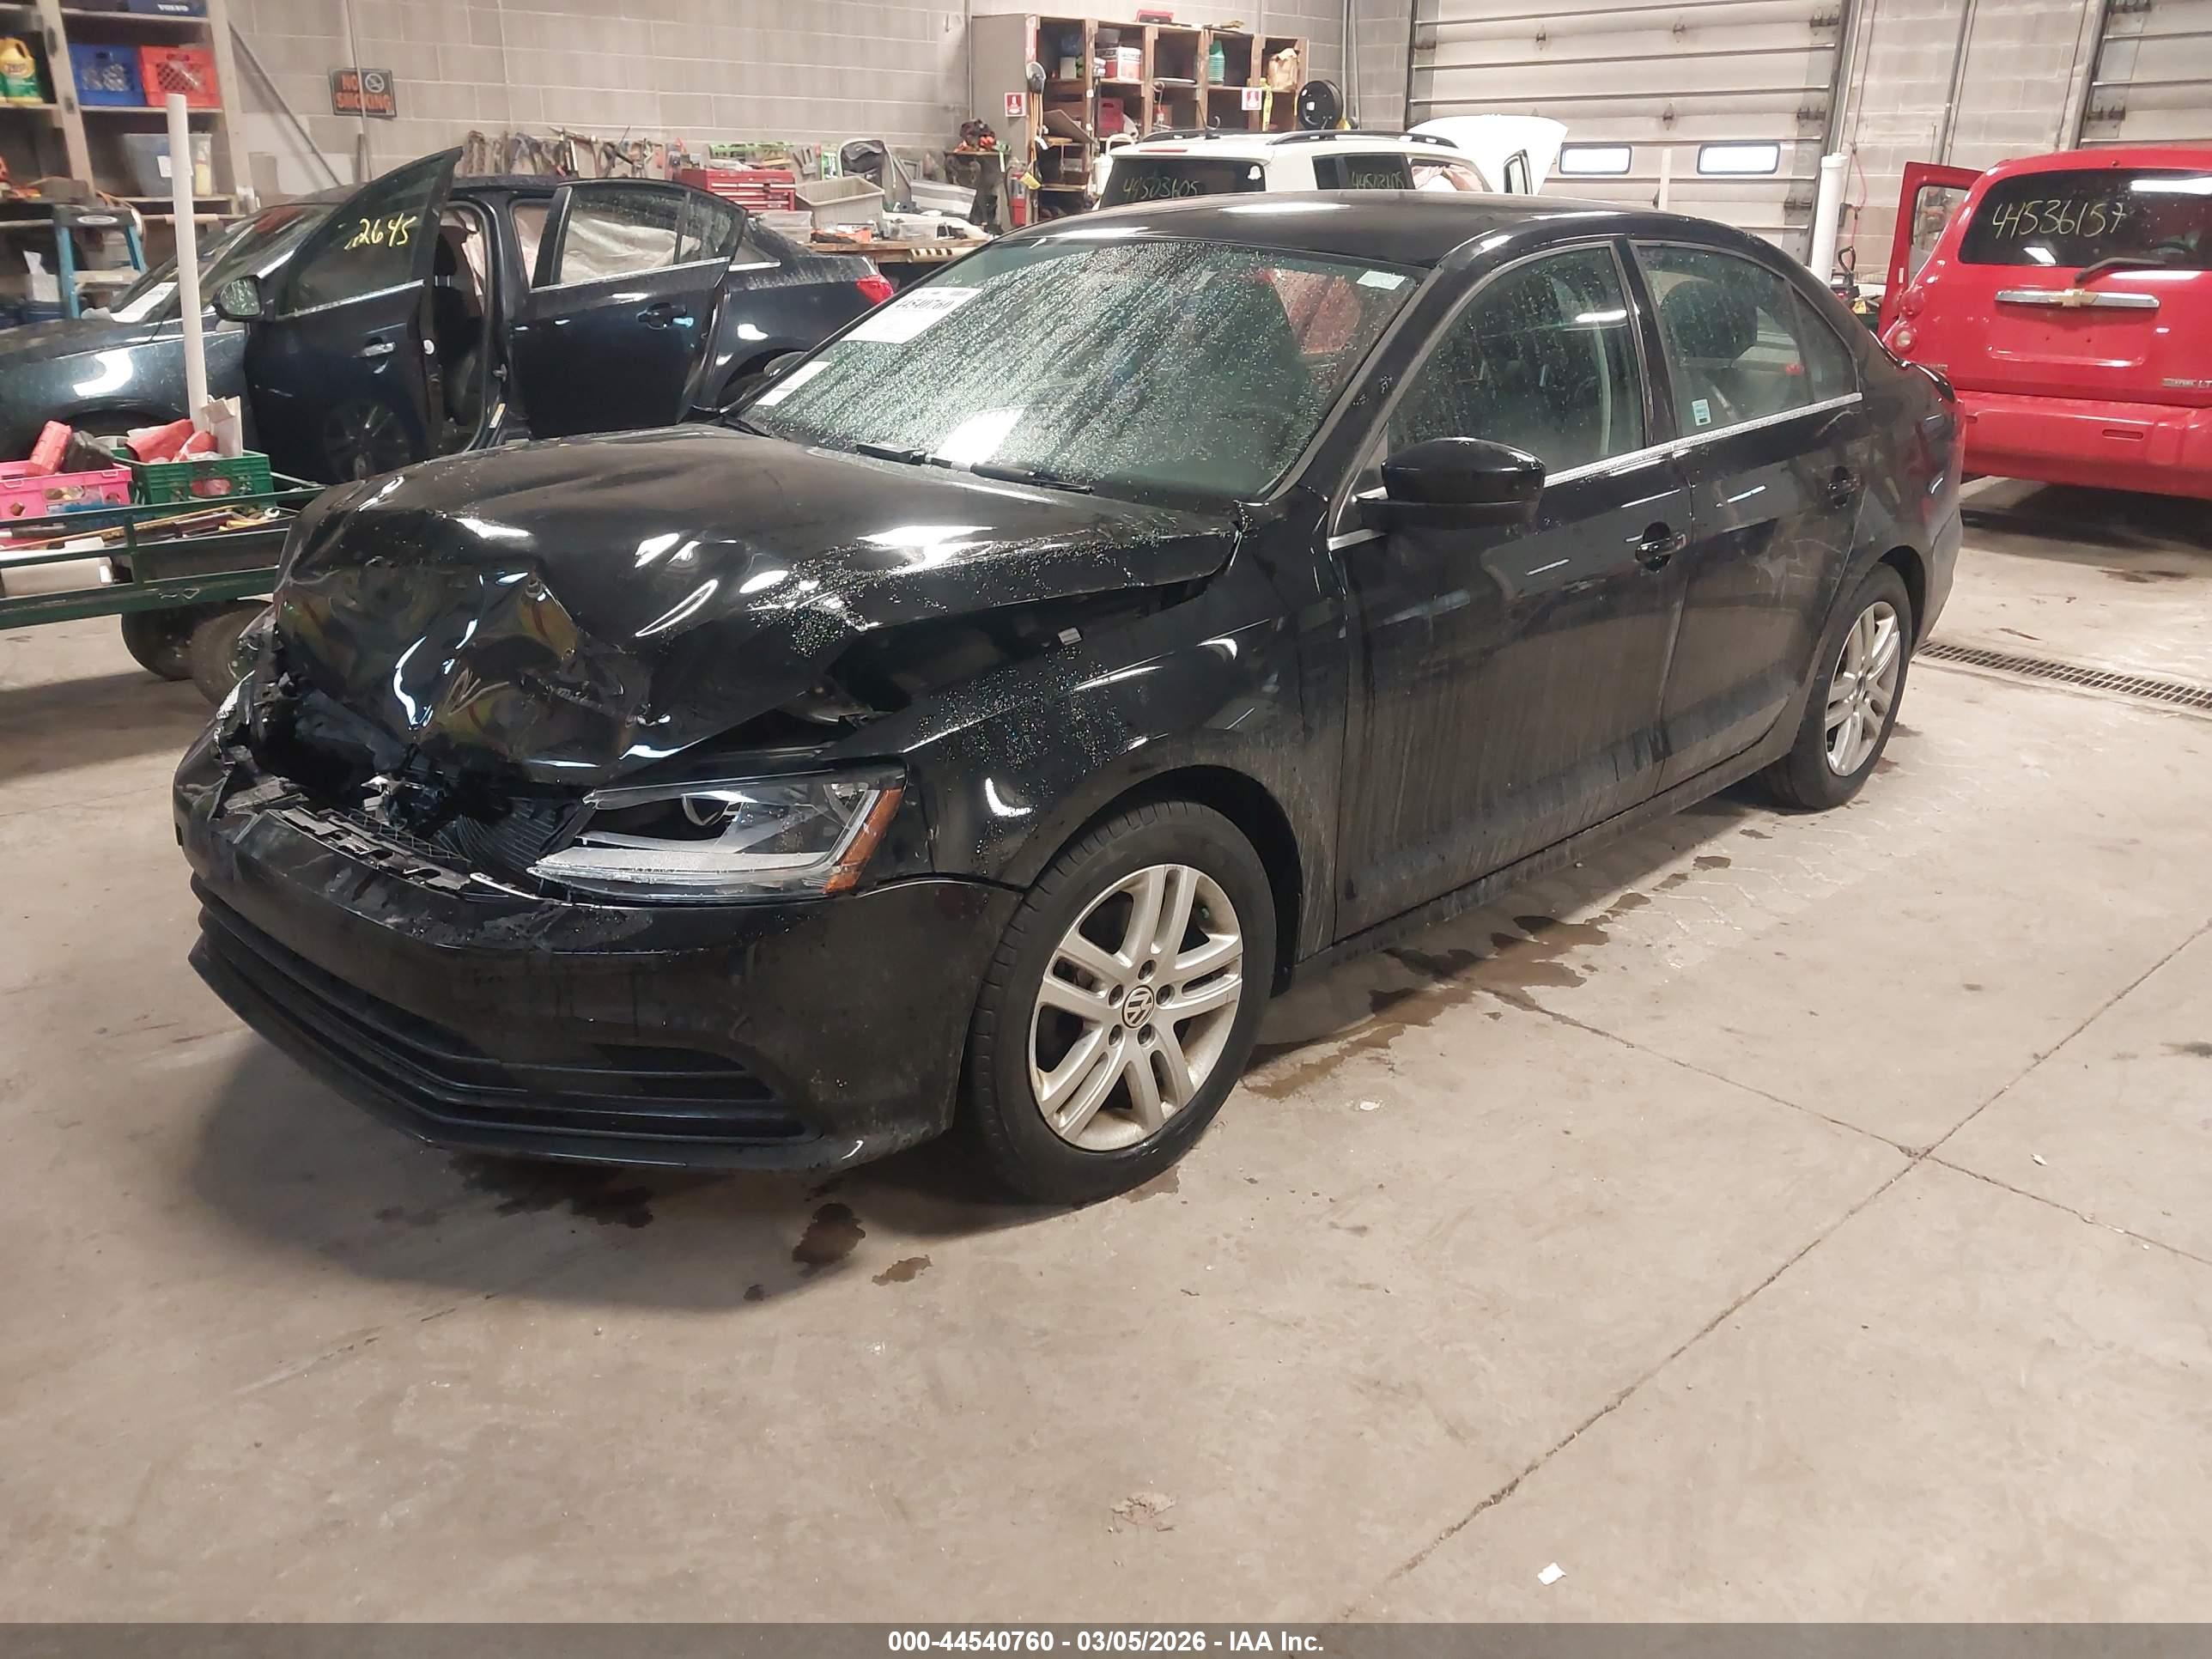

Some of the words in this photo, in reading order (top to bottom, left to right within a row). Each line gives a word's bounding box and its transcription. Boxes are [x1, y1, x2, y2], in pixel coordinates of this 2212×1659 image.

[341, 75, 359, 91] NO
[336, 92, 392, 111] SMOKING
[1992, 199, 2127, 240] 44536157
